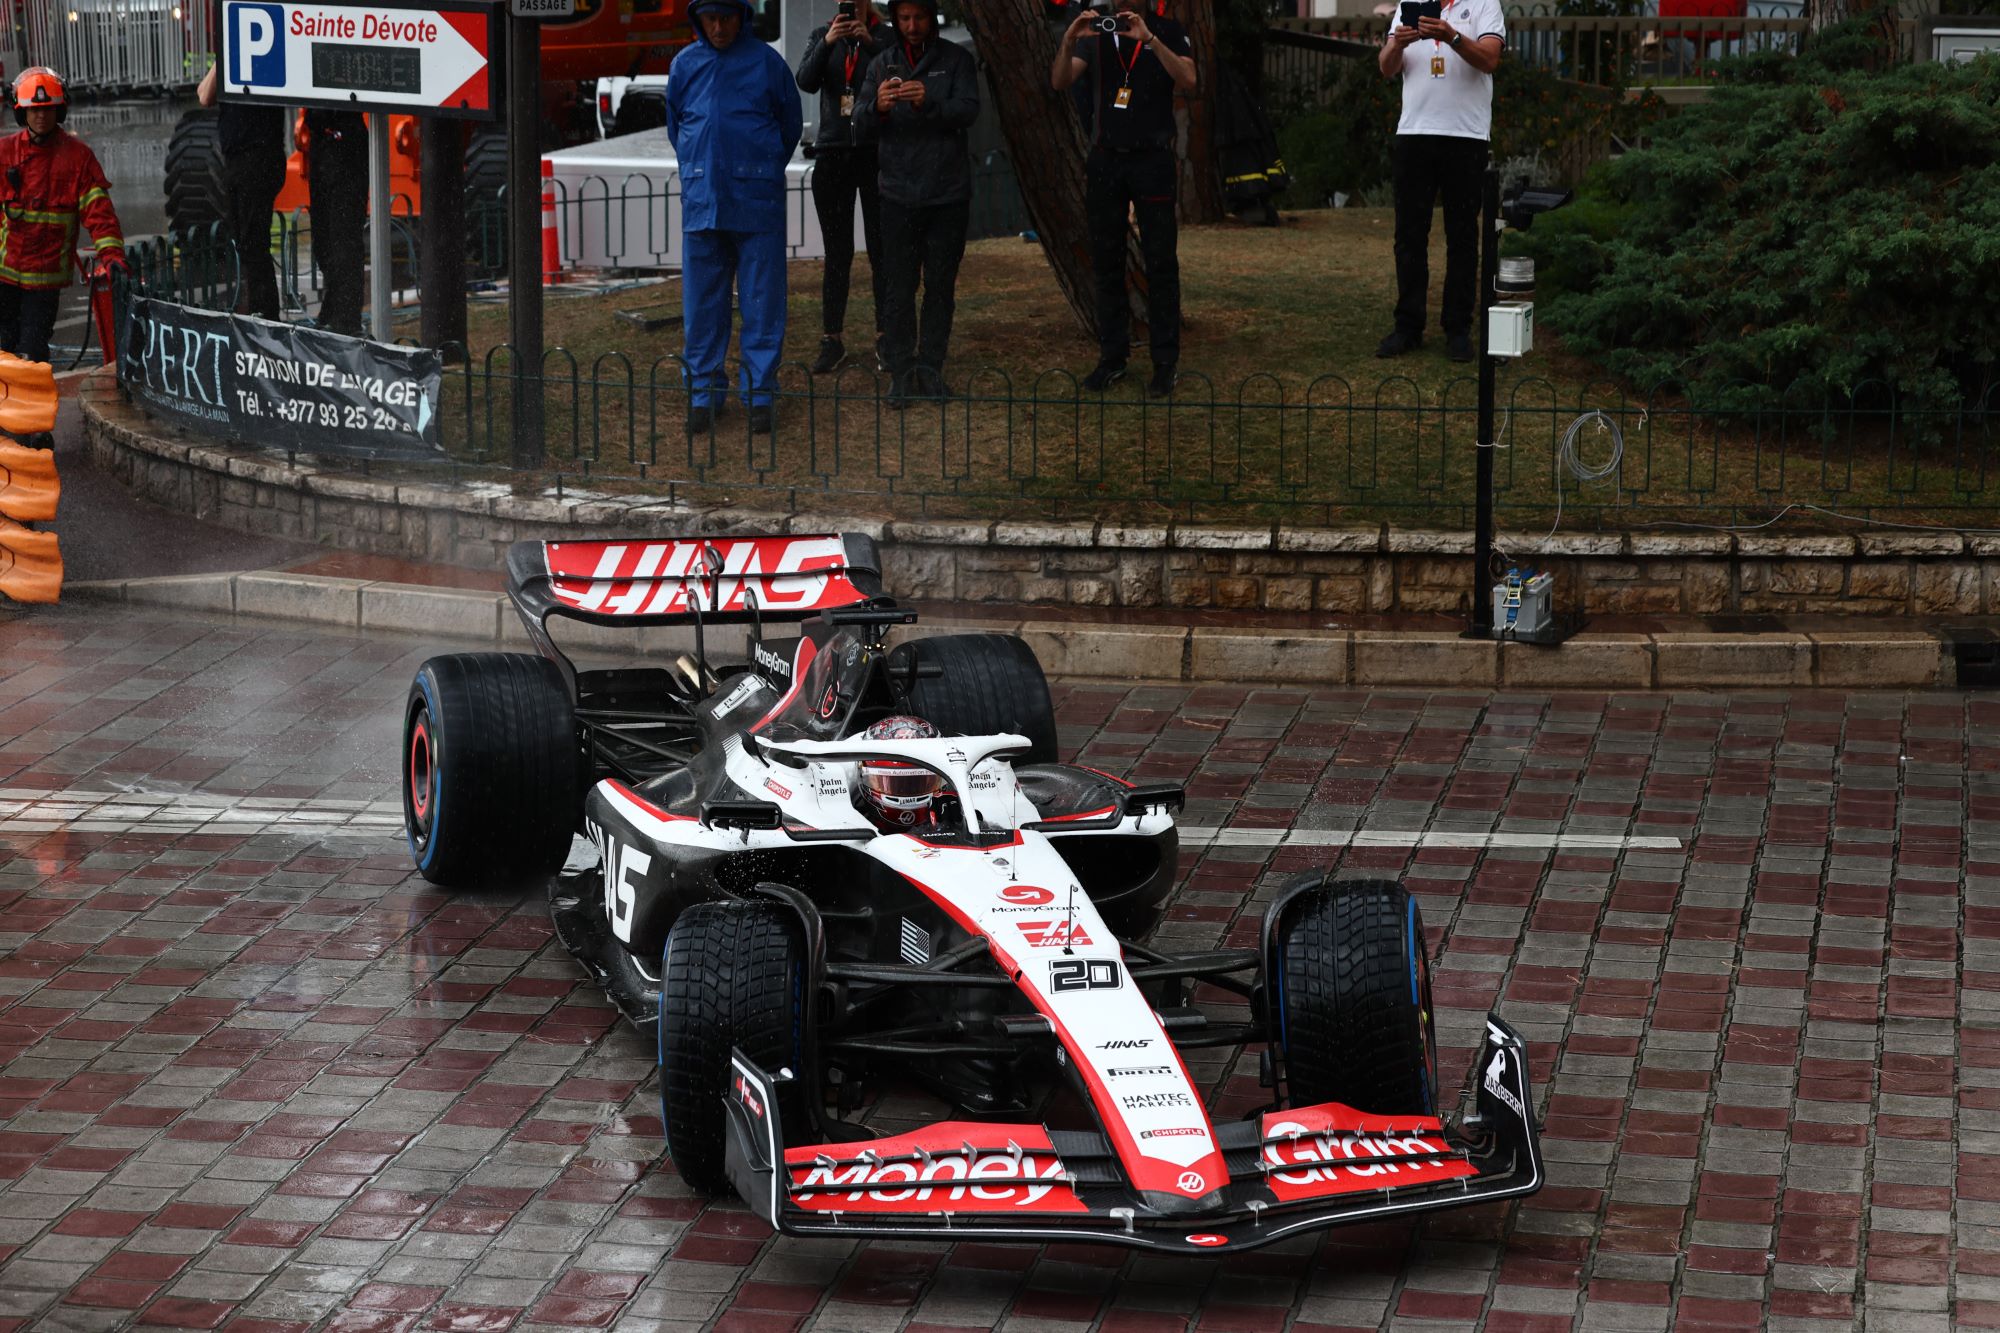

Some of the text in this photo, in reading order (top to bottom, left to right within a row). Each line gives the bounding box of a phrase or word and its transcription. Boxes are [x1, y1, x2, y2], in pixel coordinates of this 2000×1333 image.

[290, 10, 437, 43] Sainte Dévote
[124, 313, 230, 408] PERT
[235, 351, 301, 385] STATION
[305, 362, 336, 388] DE
[236, 388, 264, 417] Tél.
[277, 398, 315, 424] +377
[319, 403, 339, 428] 93
[344, 406, 368, 429] 25
[553, 541, 844, 613] HAAS
[754, 642, 791, 677] MoneyGram
[969, 773, 991, 782] Palm
[819, 779, 842, 788] Palm
[968, 781, 996, 790] Angels
[818, 787, 848, 796] Angels
[991, 905, 1080, 913] MoneyGram
[1049, 958, 1123, 994] 20
[1096, 1039, 1154, 1050] HAAS
[1107, 1066, 1173, 1077] PIRELLI
[1122, 1093, 1189, 1104] HANTEC
[1126, 1100, 1192, 1109] MARKETS
[1154, 1128, 1204, 1137] CHIPOTLE
[797, 1121, 1444, 1206] Money Gram
